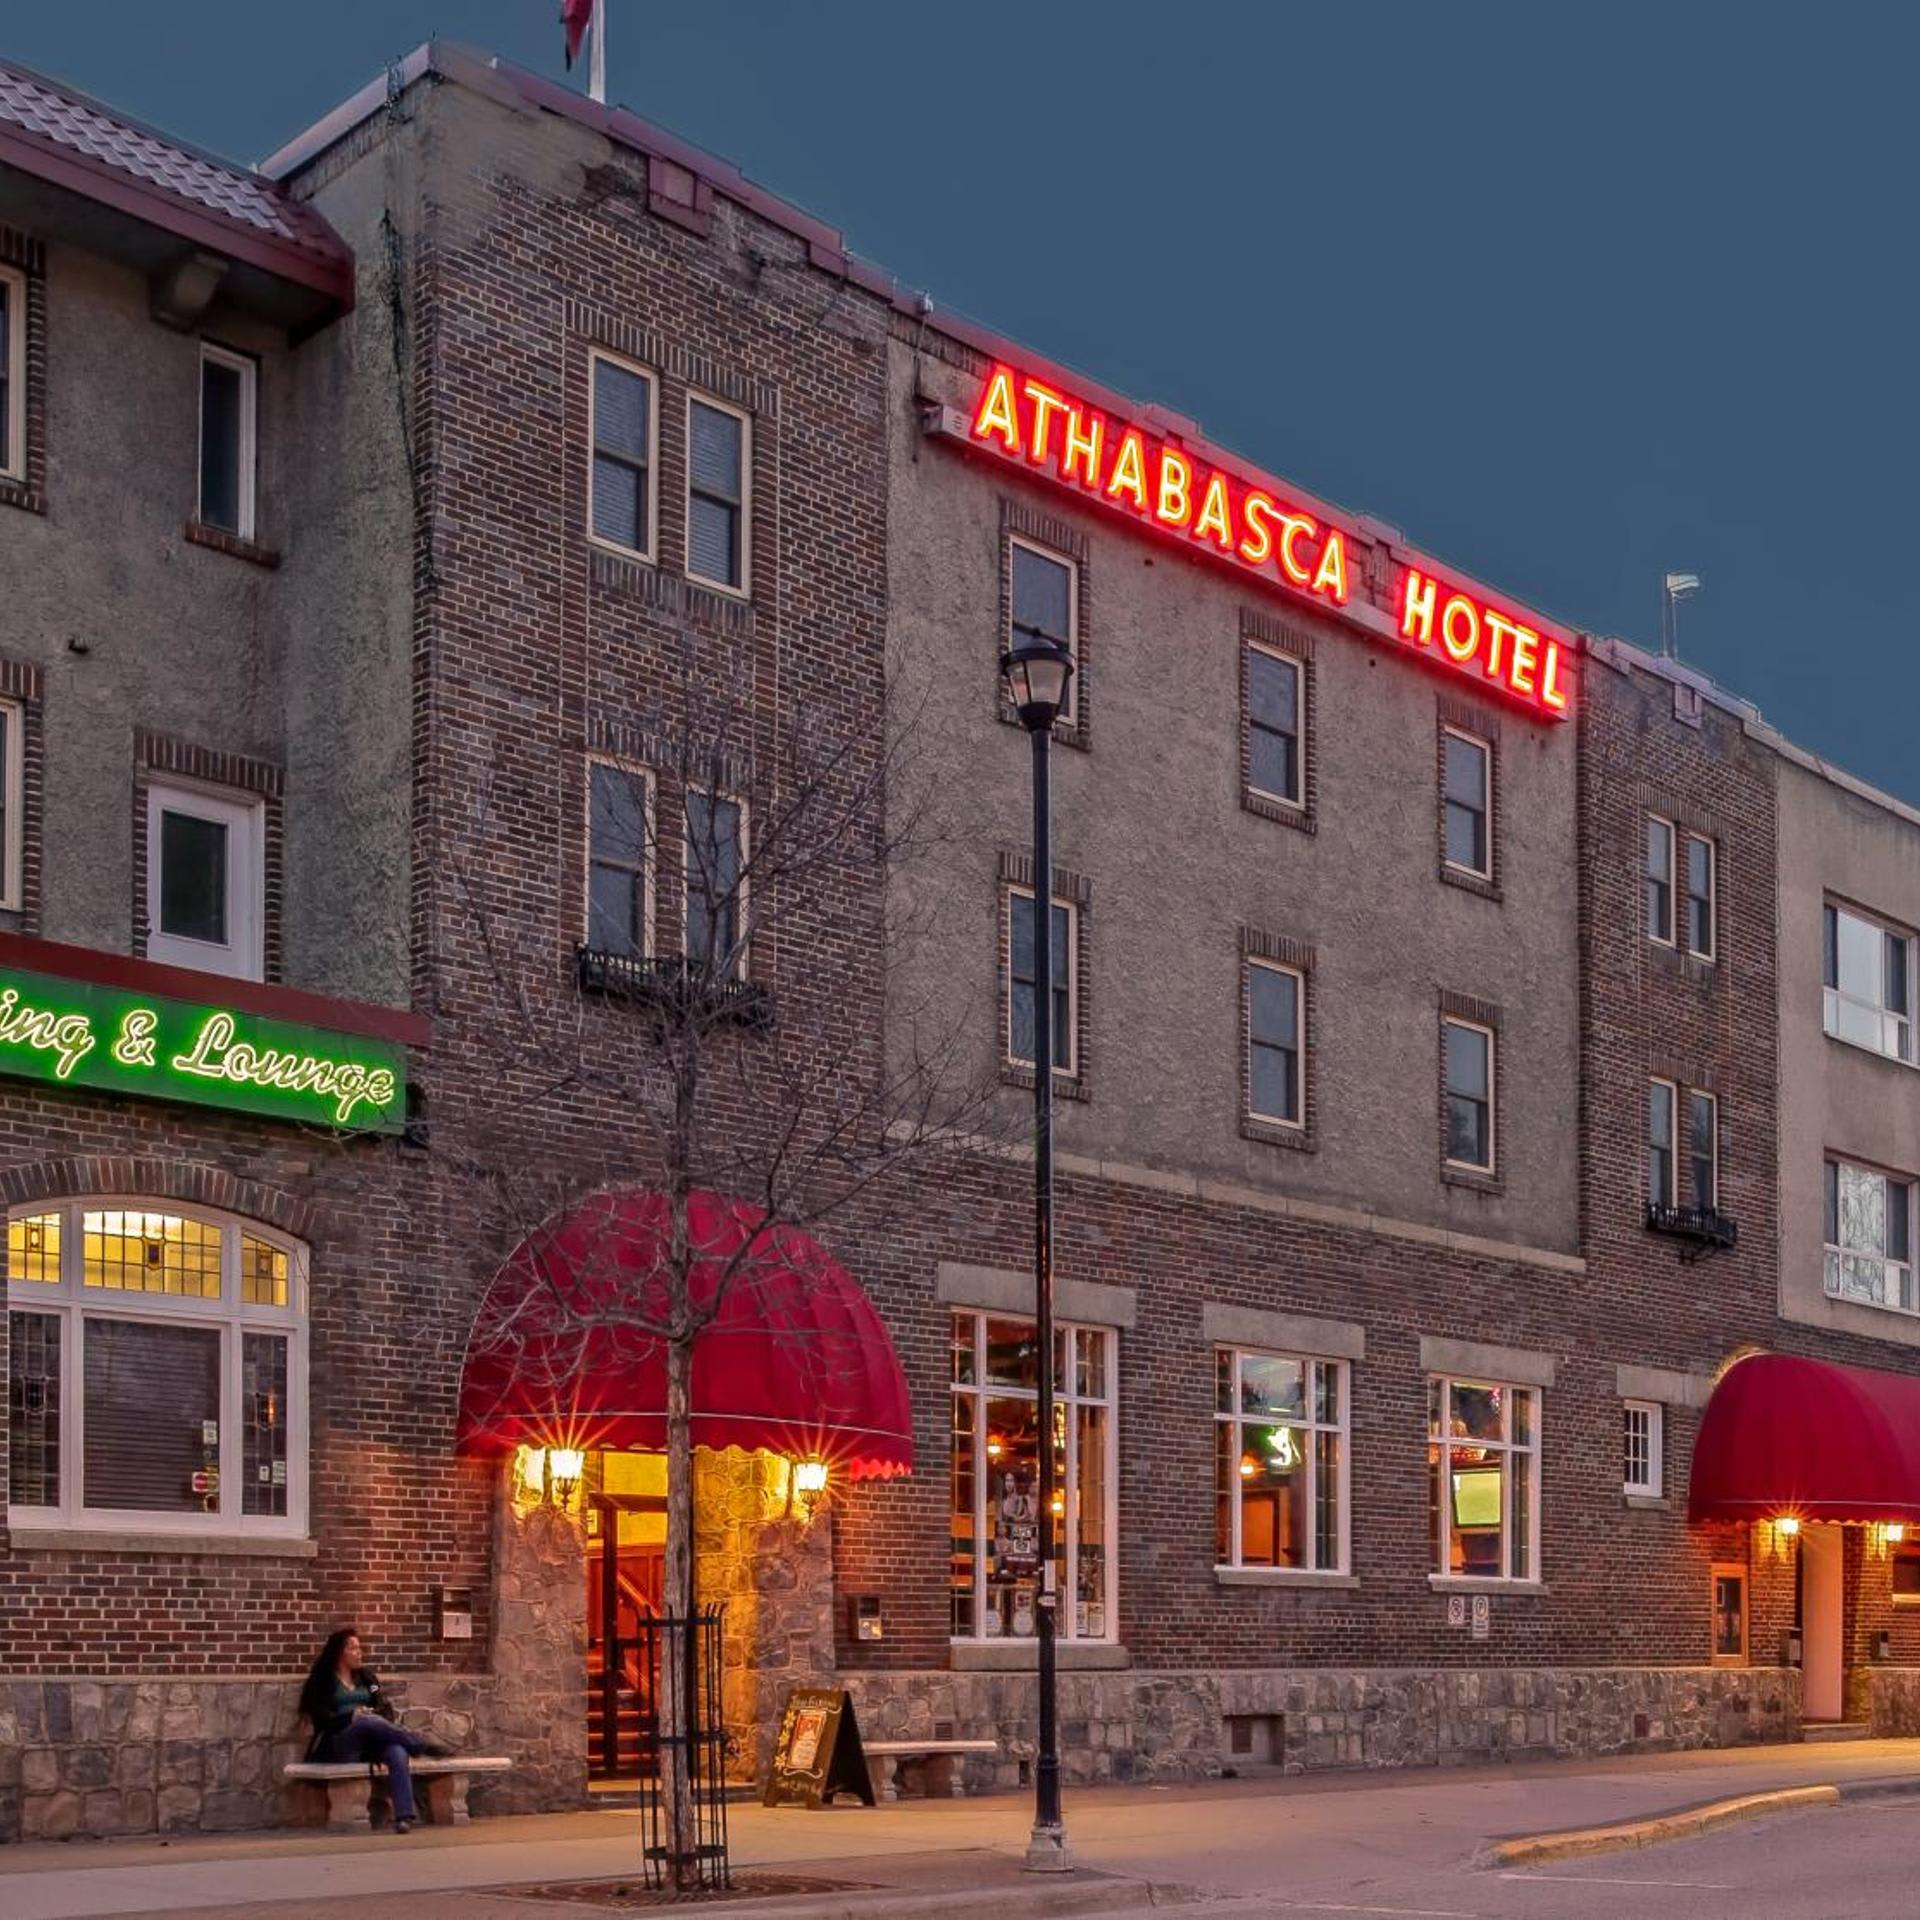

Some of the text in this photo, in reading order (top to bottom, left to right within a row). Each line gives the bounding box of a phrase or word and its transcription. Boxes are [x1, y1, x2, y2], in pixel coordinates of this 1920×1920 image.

[976, 367, 1565, 708] ATHABASCA HOTEL
[116, 1009, 156, 1066] &
[172, 1012, 394, 1122] Lounge
